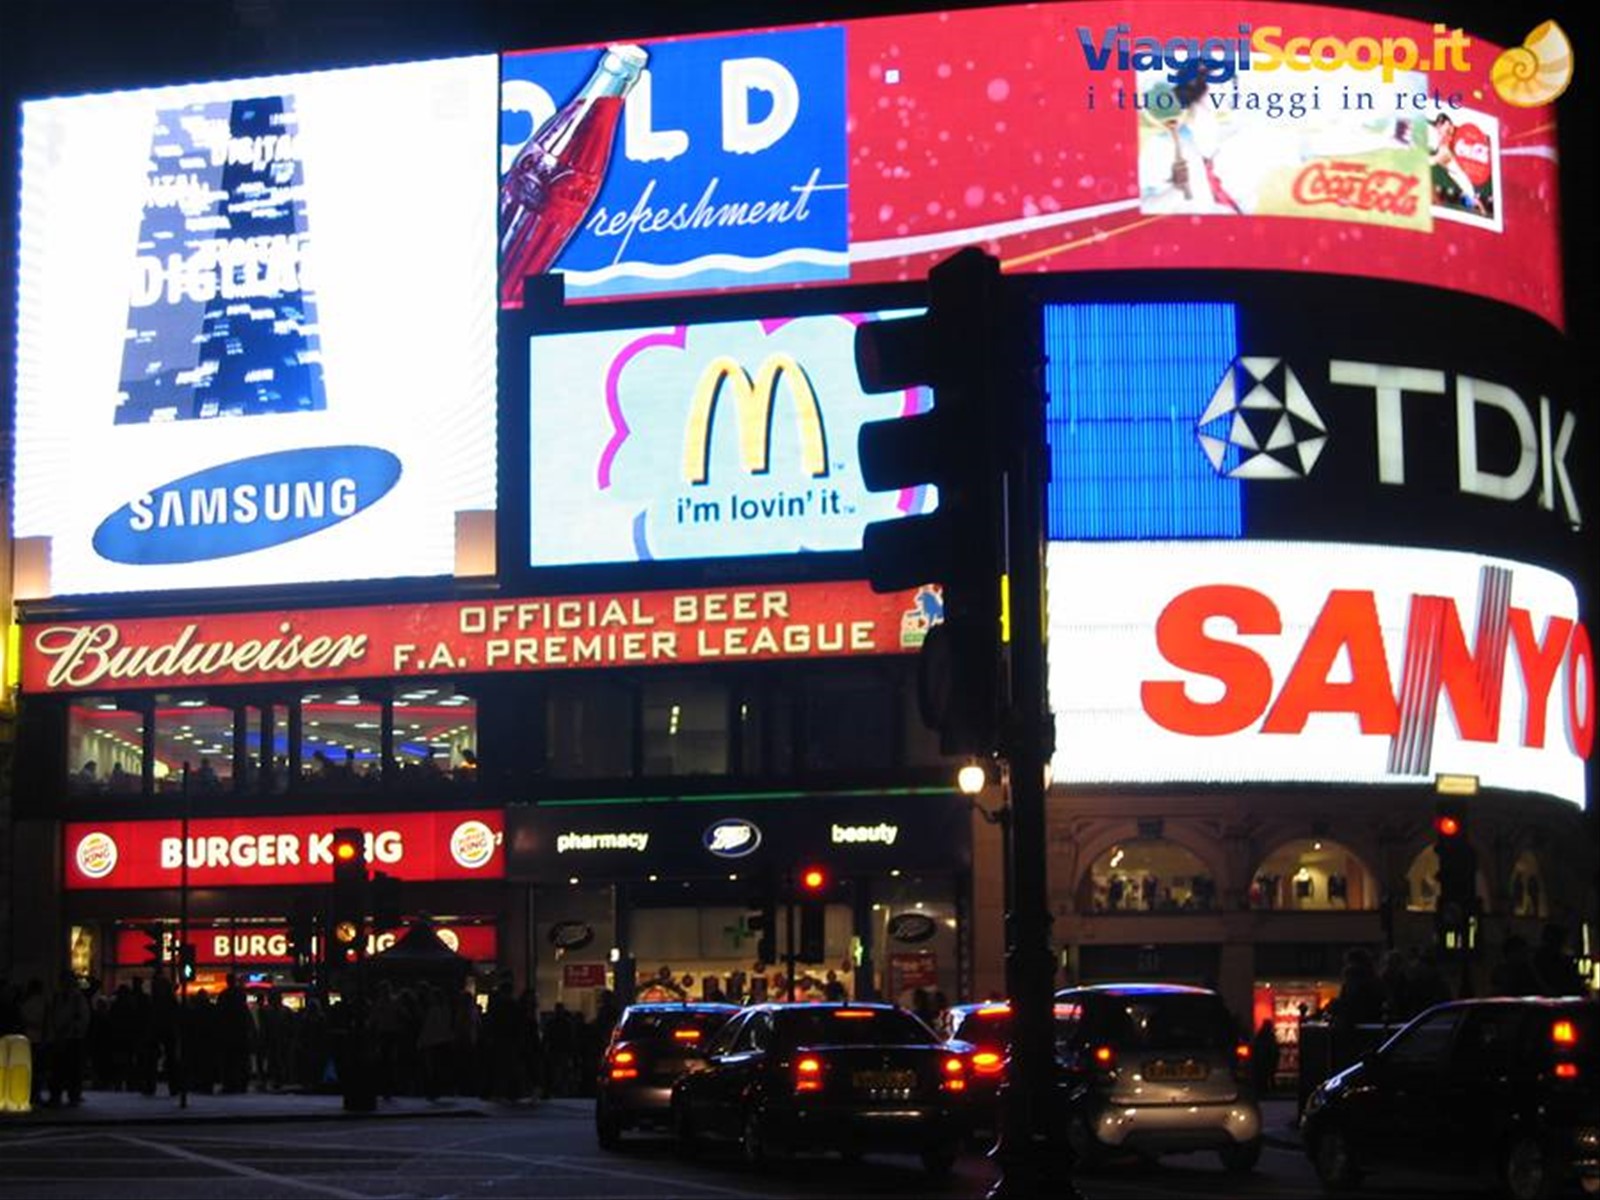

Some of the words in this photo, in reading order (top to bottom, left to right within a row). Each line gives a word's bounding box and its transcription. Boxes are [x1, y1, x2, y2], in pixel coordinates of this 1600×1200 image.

[1329, 359, 1582, 531] TDK
[129, 477, 357, 531] SAMSUNG
[677, 498, 720, 524] i'm
[730, 491, 812, 521] lovin'
[821, 490, 841, 515] it
[459, 597, 655, 634] OFFICIAL
[673, 590, 790, 623] BEER
[35, 622, 367, 688] Budweiser
[393, 642, 467, 671] F.A.
[486, 629, 678, 666] PREMIER
[698, 621, 875, 656] LEAGUE
[1141, 566, 1596, 776] SANYO
[161, 833, 300, 869] BURGER
[557, 831, 649, 854] pharmacy
[831, 823, 898, 846] beauty
[214, 934, 295, 957] BURG
